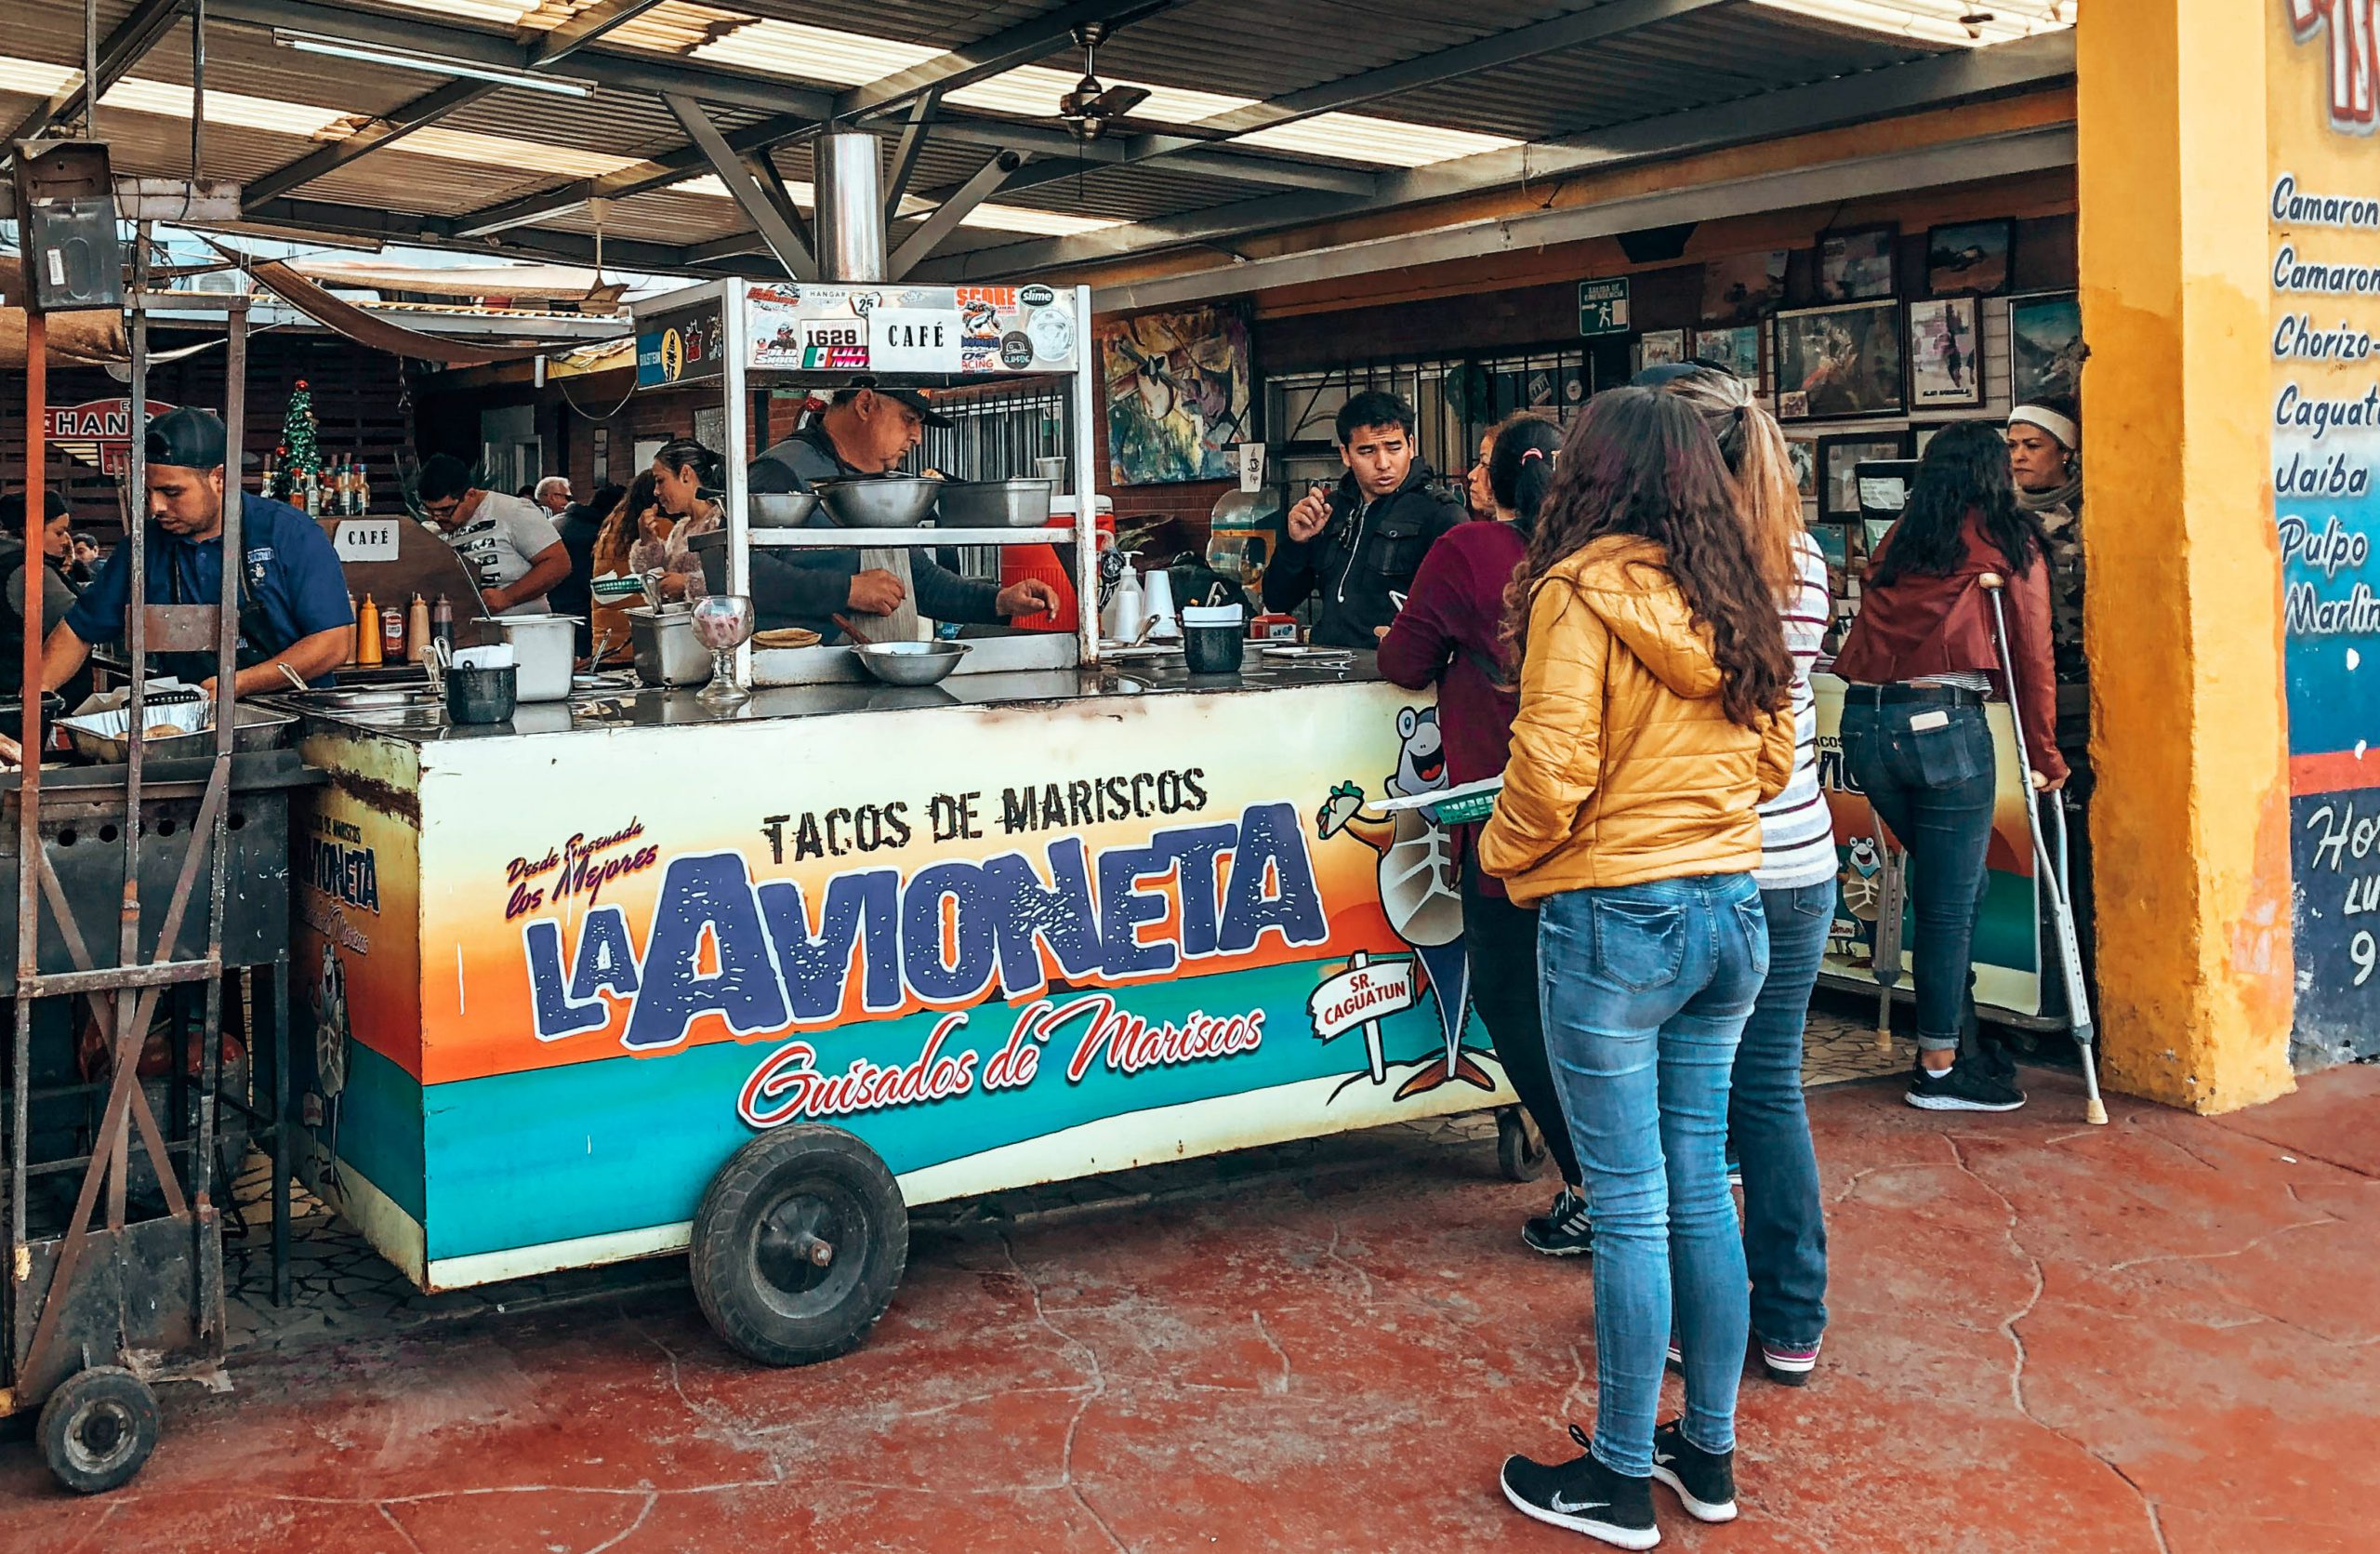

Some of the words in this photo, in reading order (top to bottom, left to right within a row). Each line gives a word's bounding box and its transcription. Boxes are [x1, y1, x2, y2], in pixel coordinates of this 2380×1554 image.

[2273, 177, 2379, 225] Camaron
[2274, 247, 2380, 291] Camaron
[957, 287, 1016, 306] SCORE
[1023, 289, 1052, 302] slime
[806, 329, 857, 346] 1628
[888, 321, 944, 348] CAFÉ
[832, 357, 869, 367] MO
[962, 359, 995, 369] ACING
[56, 411, 130, 435] HAN
[2276, 385, 2380, 439] Caguat
[2276, 452, 2368, 493] Jaiba
[348, 527, 389, 546] CAFÉ
[2278, 517, 2366, 575] Pulpo
[2283, 586, 2380, 630] Marlin
[760, 801, 913, 865] TACOS
[926, 790, 982, 842] DE
[997, 767, 1209, 833] MARISCOS
[506, 846, 561, 885] Desde
[563, 815, 645, 863] Ensenada
[551, 843, 659, 907] Mejores
[522, 904, 640, 1042] LA
[620, 801, 1329, 1051] AVIONETA
[2351, 931, 2376, 986] 9
[1324, 980, 1408, 1025] CAGUATUN
[1349, 971, 1376, 994] SR.
[737, 1011, 976, 1128] Guisados
[983, 1001, 1054, 1090] de
[1035, 995, 1265, 1082] Mariscos
